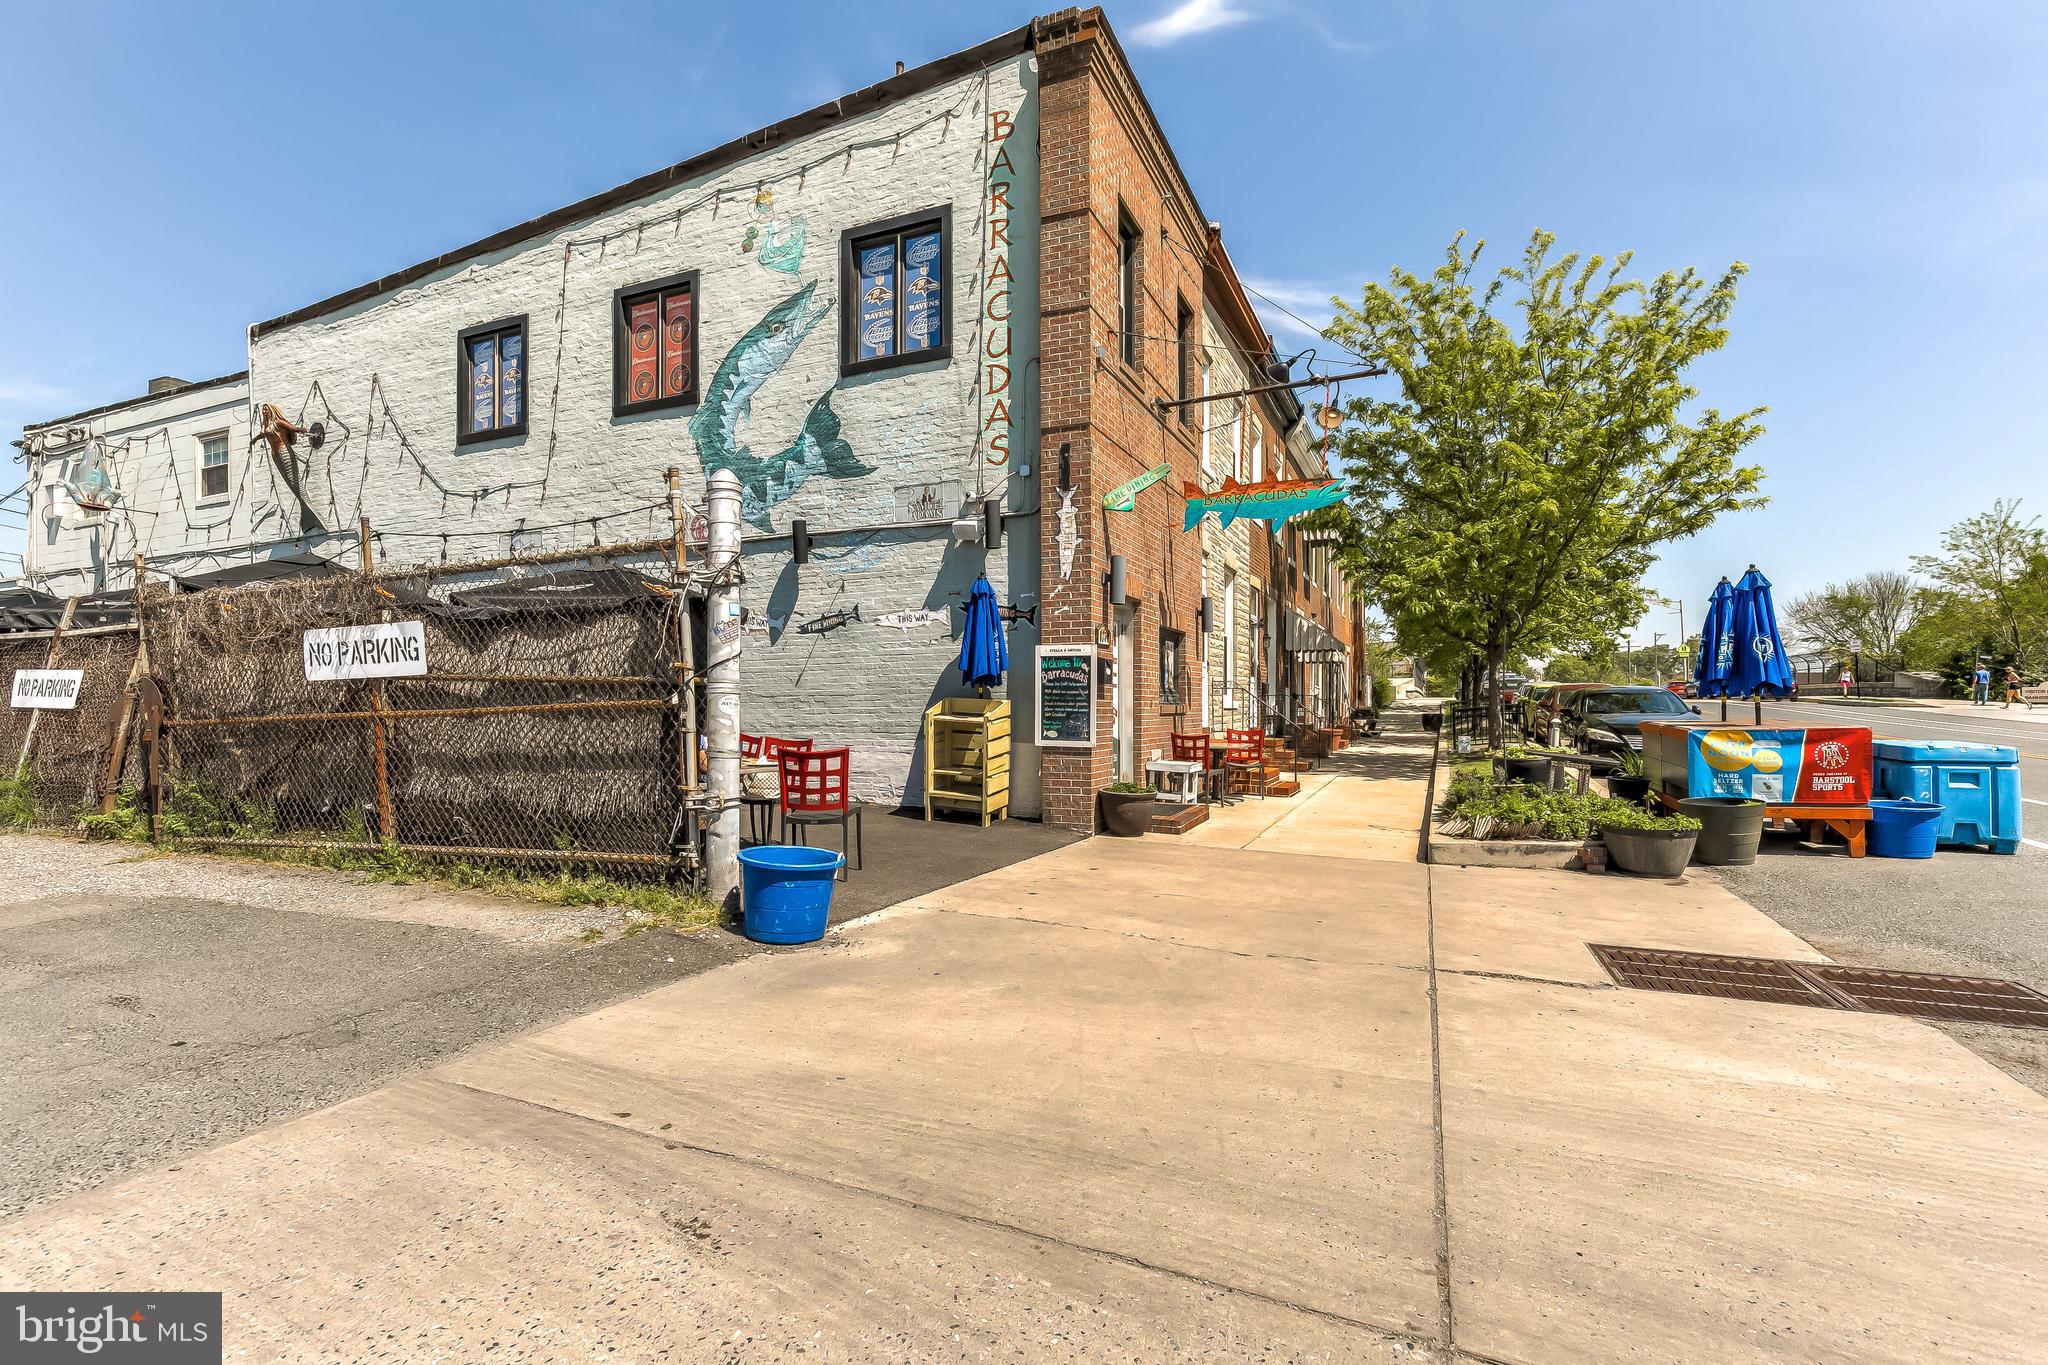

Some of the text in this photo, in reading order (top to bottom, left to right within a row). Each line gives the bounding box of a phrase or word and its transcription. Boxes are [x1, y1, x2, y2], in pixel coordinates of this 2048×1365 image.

[984, 110, 1017, 466] BARRACUDAS
[908, 300, 940, 312] RAVENS
[864, 308, 894, 320] RAVENS
[1126, 472, 1157, 493] DINING
[1204, 487, 1309, 506] BARRACUDAS
[897, 612, 929, 625] THIS WAY
[808, 620, 823, 632] FINE
[308, 636, 420, 667] NO PARKING
[1041, 669, 1089, 684] Barracudas
[17, 678, 76, 698] NO PARKING
[1706, 749, 1751, 758] NOON
[1812, 775, 1855, 784] BARSTOOL
[1812, 783, 1843, 791] SPORTS
